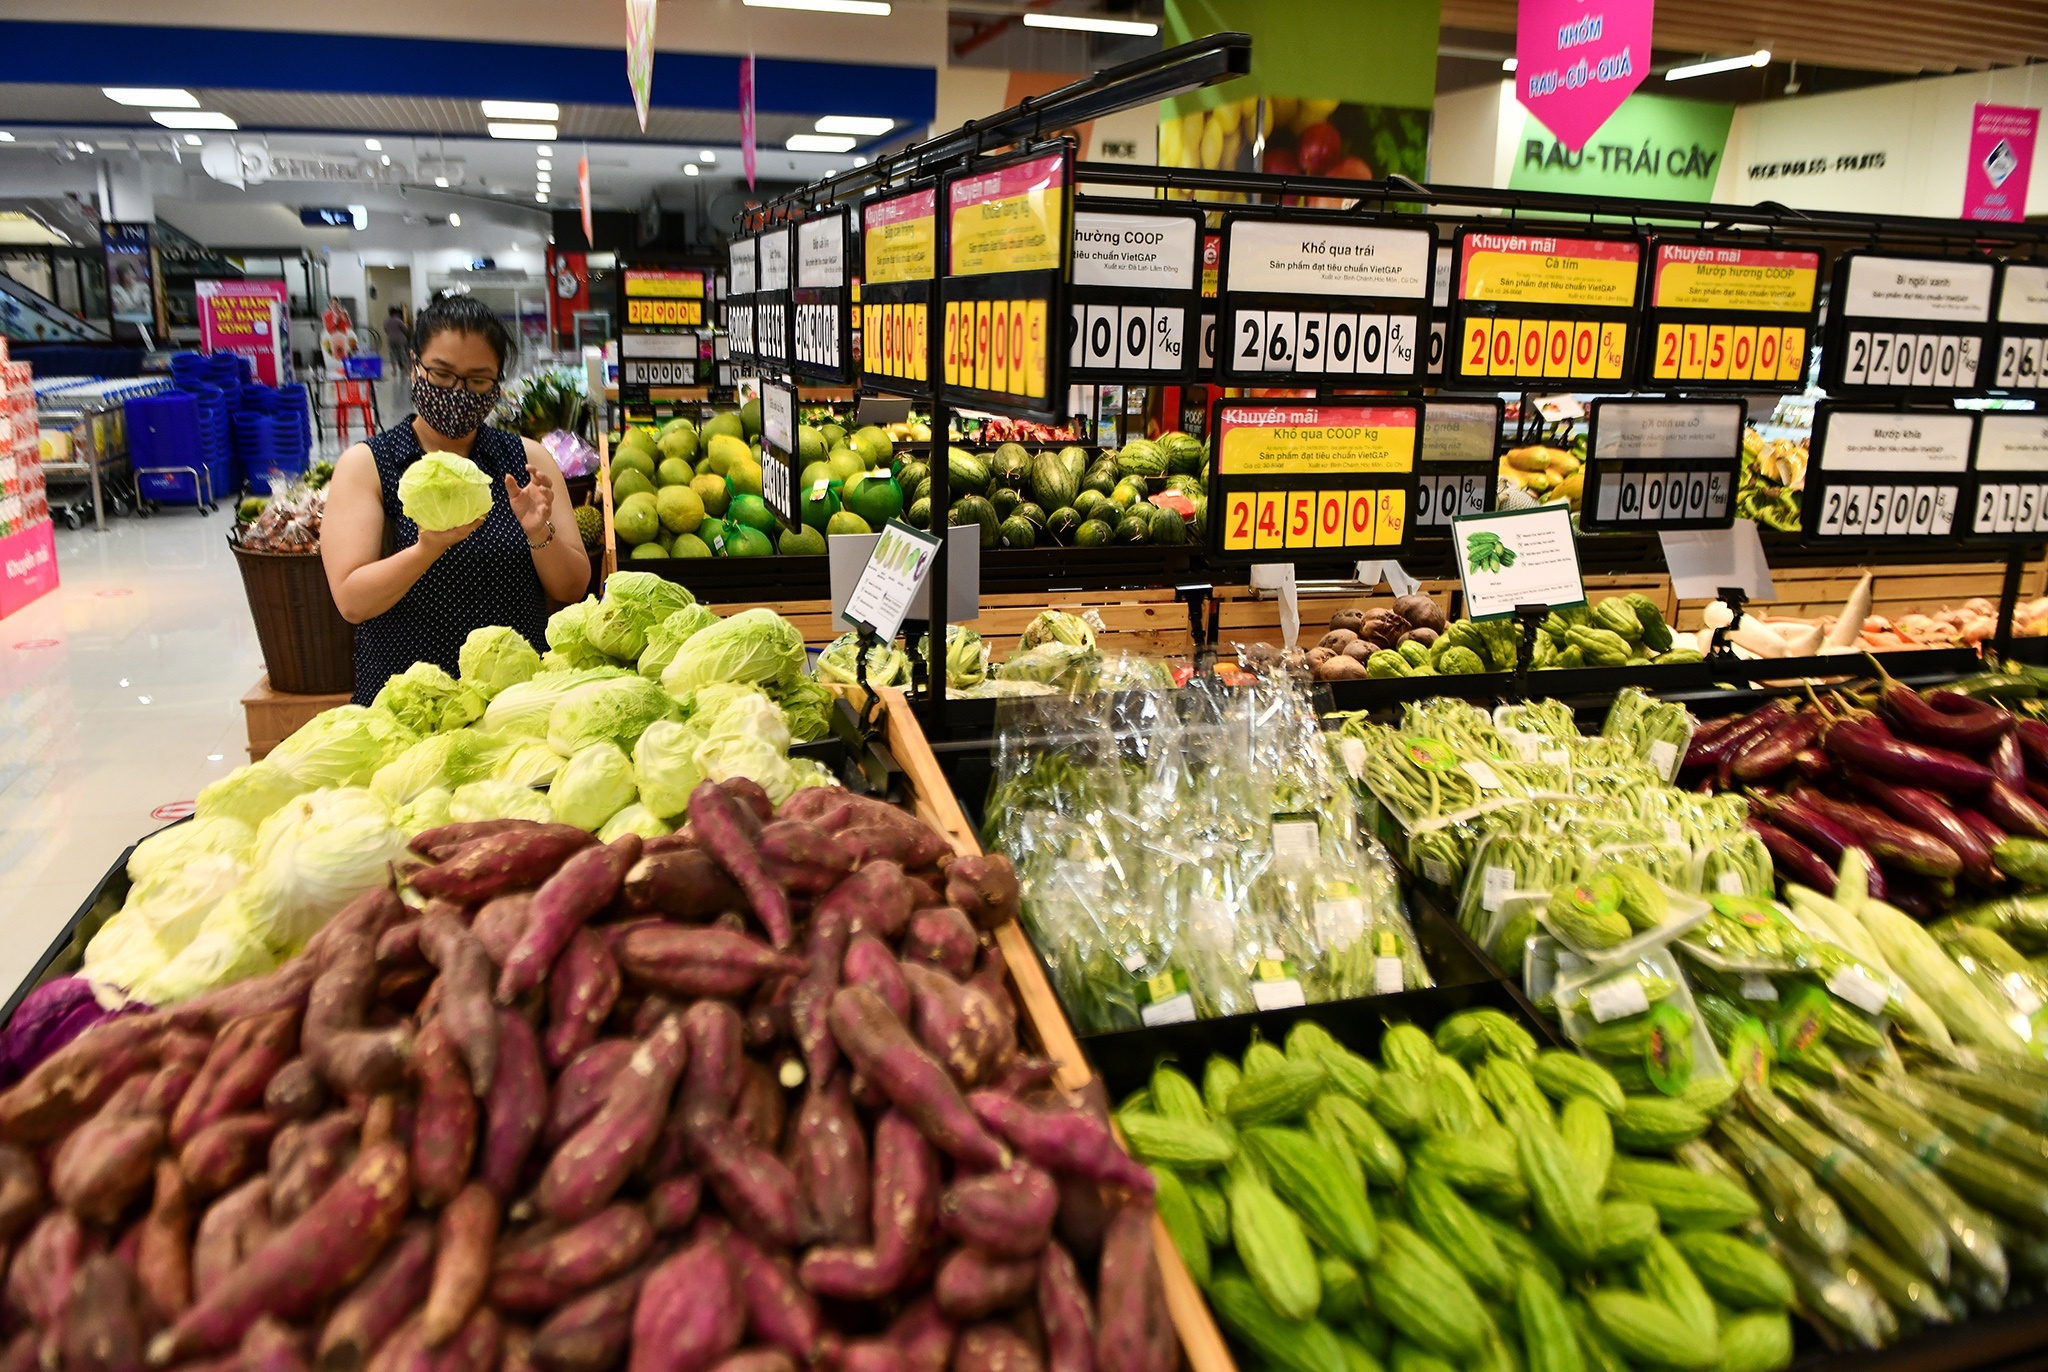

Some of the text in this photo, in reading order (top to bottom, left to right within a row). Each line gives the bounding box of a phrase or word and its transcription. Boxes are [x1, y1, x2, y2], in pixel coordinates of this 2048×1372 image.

[1558, 13, 1603, 50] NHÓM
[1529, 69, 1558, 99] RAU
[1667, 143, 1717, 180] CÂY
[1124, 232, 1164, 245] COOP
[1530, 237, 1556, 253] mãi
[1072, 250, 1157, 262] tiêu chuẩn VietGAP
[1302, 241, 1374, 257] Khổ qua trái
[1717, 249, 1741, 263] mãi
[1270, 260, 1402, 274] Sản phẩm đạt tiêu chuẩn VietGAP
[1545, 257, 1579, 270] Cà tím
[1697, 265, 1795, 281] Mướp hương COOP
[1550, 281, 1564, 289] tiêu
[1565, 281, 1586, 291] chuẩn
[1588, 285, 1616, 293] VietGAP
[948, 312, 1024, 372] 23.900
[1241, 319, 1381, 362] 26.500
[1469, 329, 1592, 366] 20.000
[1662, 332, 1776, 370] 21.500
[1853, 339, 1954, 376] 27.000
[1225, 407, 1318, 427] Khuyến mãi
[1274, 426, 1378, 442] Khổ qua COOP kg
[1260, 450, 1389, 461] Sản phẩm đạt tiêu chuẩn VietGAP
[1622, 480, 1704, 513] 0.000
[1232, 497, 1369, 537] 24.500
[1827, 492, 1931, 526] 26.500
